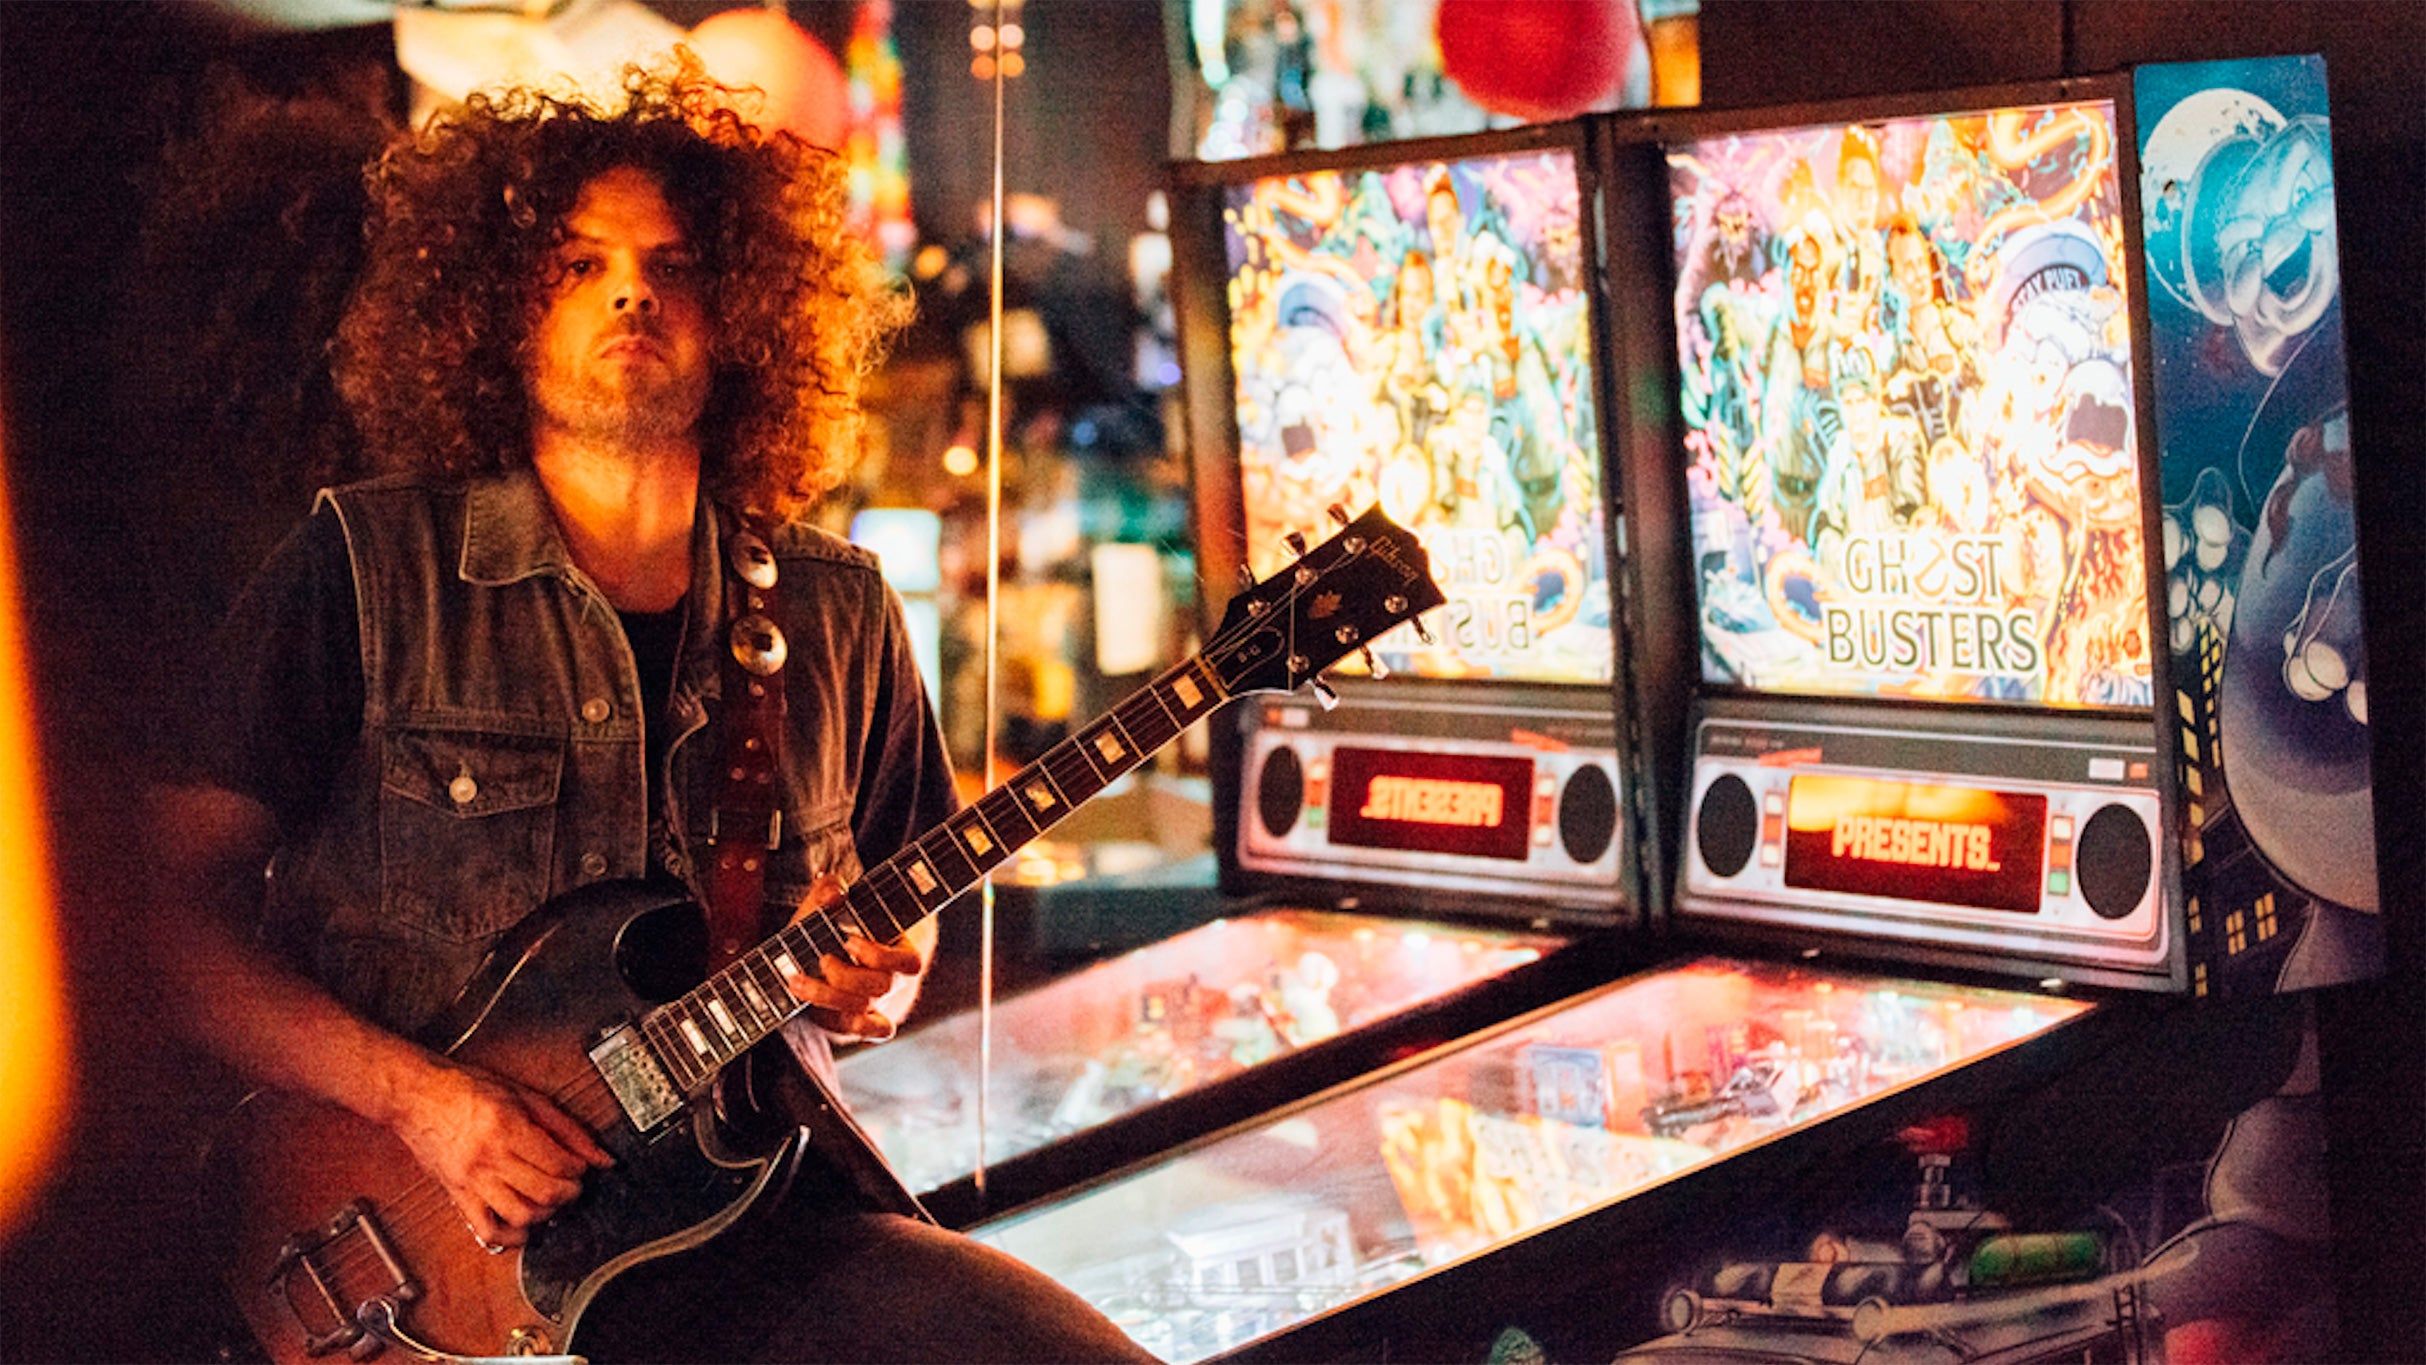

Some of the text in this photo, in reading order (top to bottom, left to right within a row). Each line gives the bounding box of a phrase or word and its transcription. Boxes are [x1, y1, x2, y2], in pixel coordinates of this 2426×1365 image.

[1366, 535, 1420, 588] Gibson
[1845, 538, 2003, 598] GHOST
[1827, 608, 2038, 673] BUSTERS
